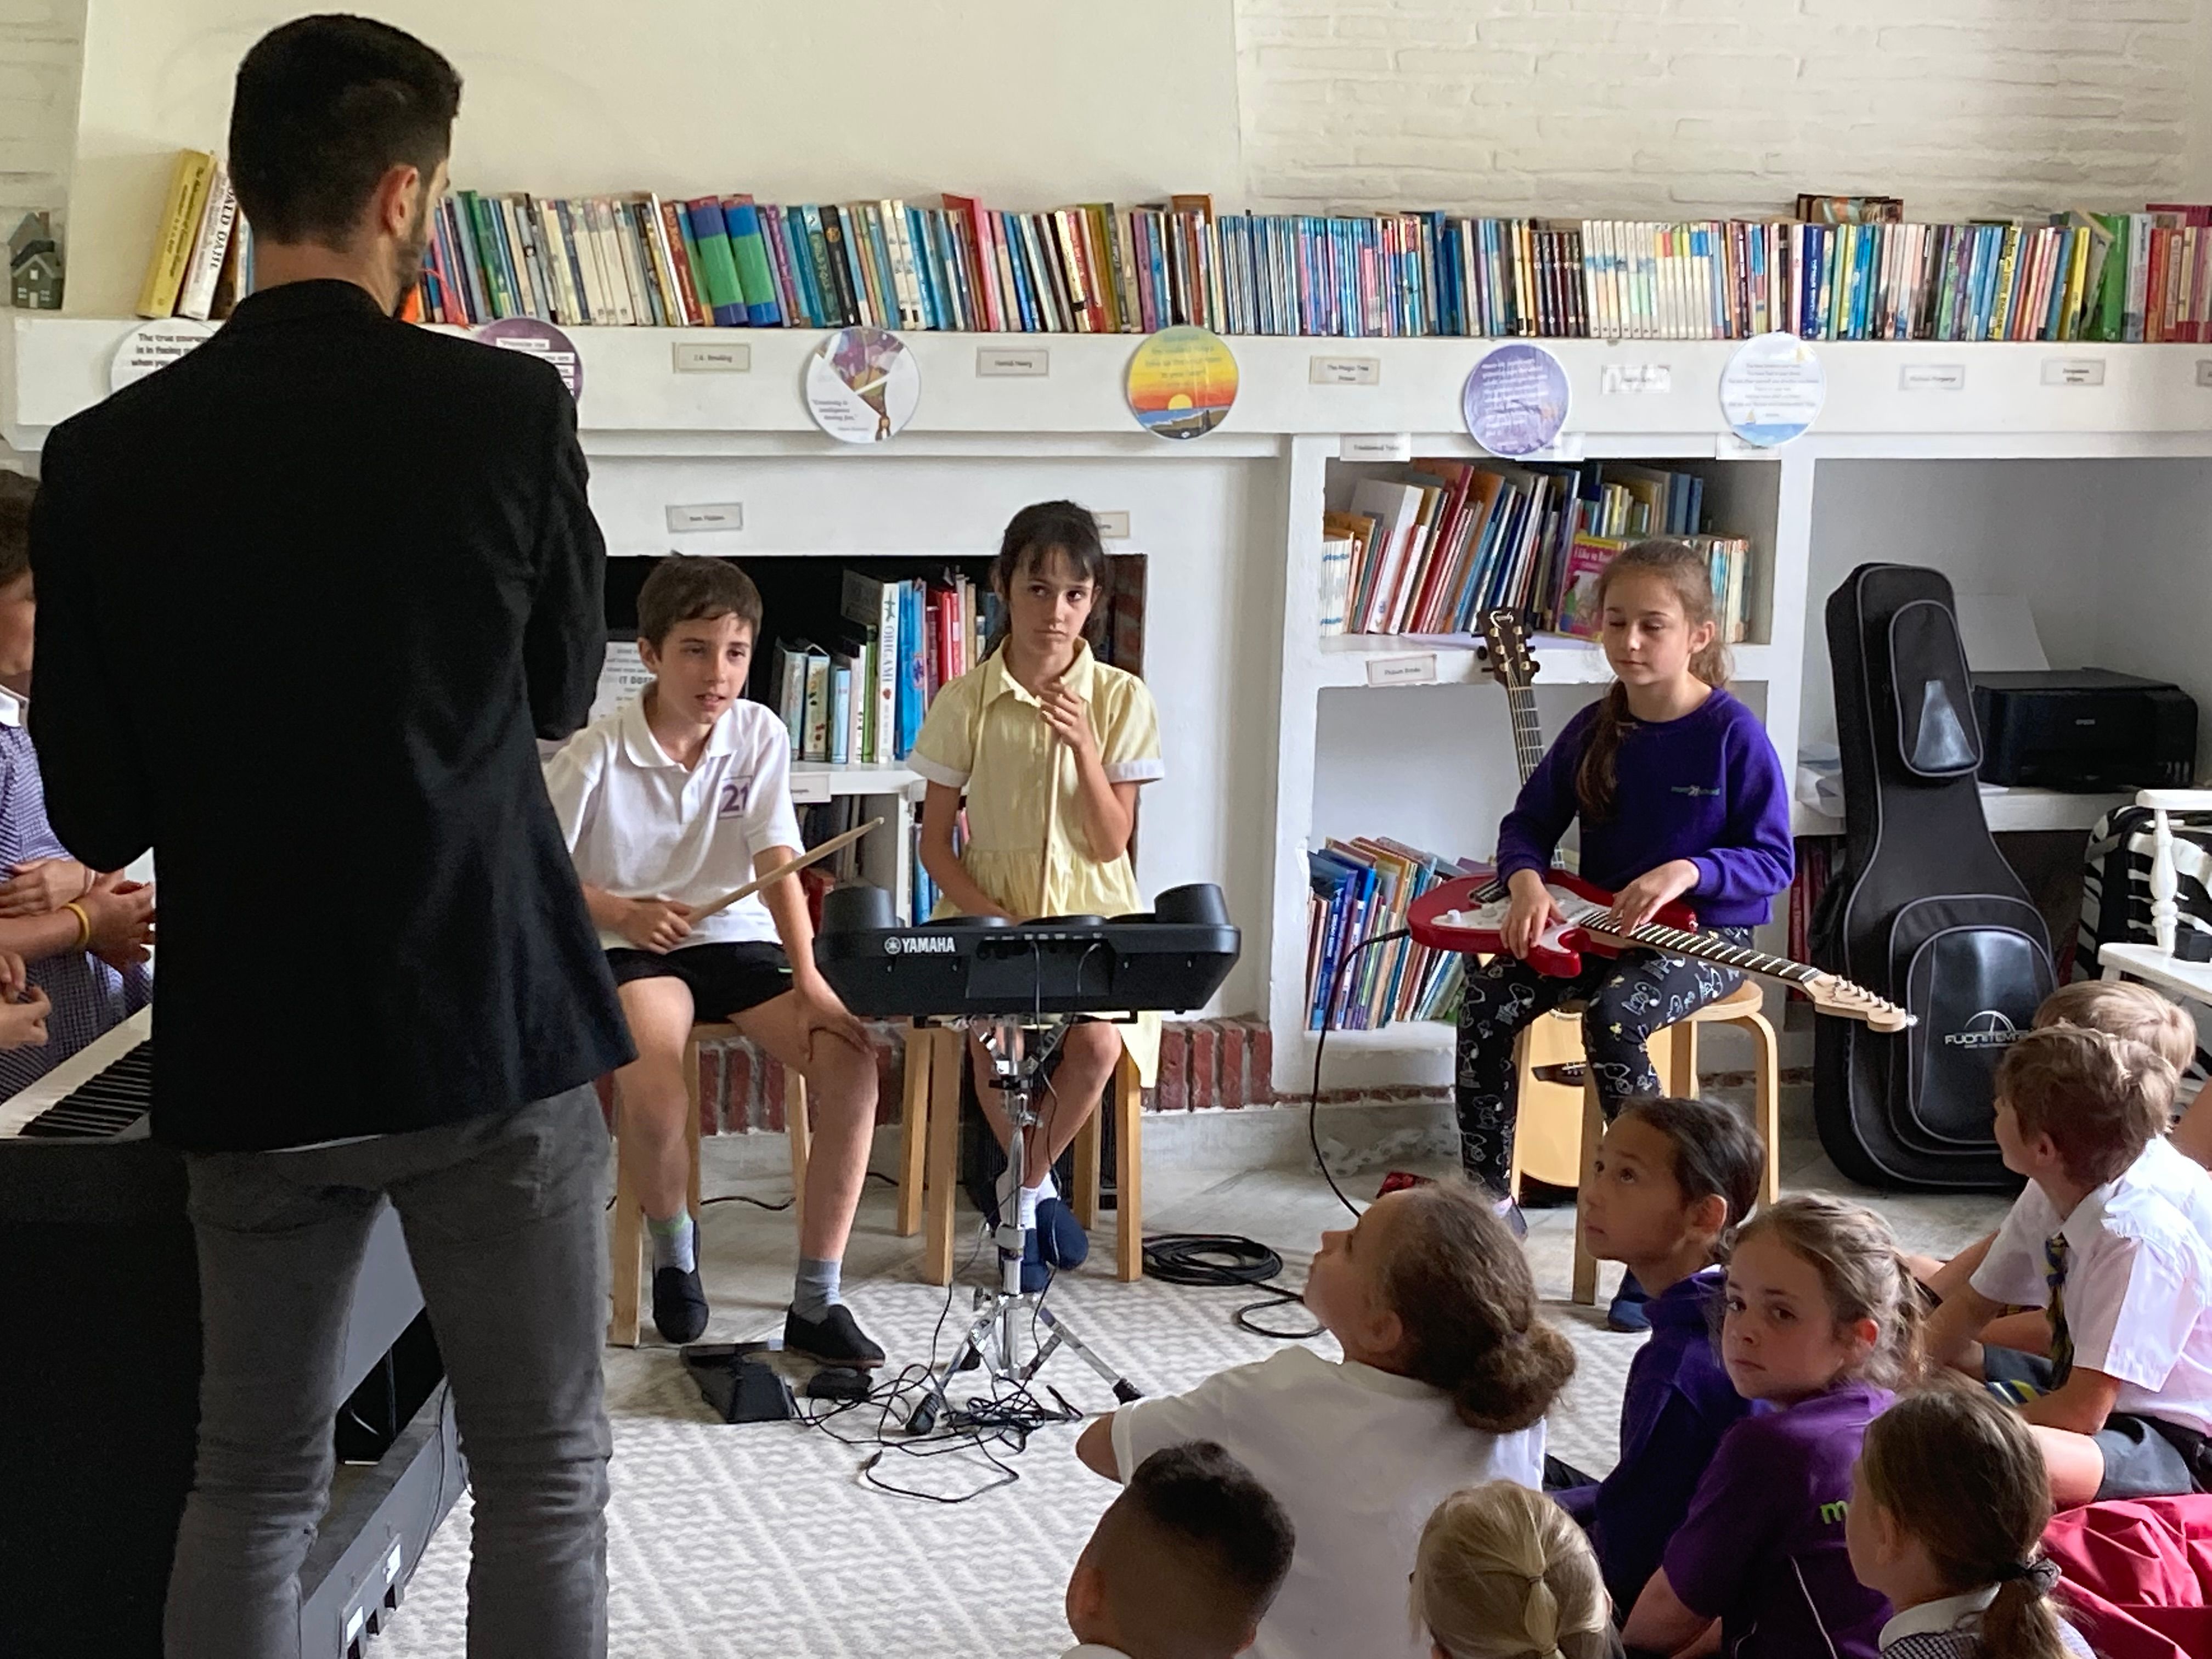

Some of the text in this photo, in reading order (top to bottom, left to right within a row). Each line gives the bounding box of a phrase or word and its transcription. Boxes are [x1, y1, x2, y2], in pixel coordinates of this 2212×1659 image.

[882, 625, 895, 682] ORIGAMI
[721, 783, 749, 812] 21
[901, 936, 956, 953] YAMAHA
